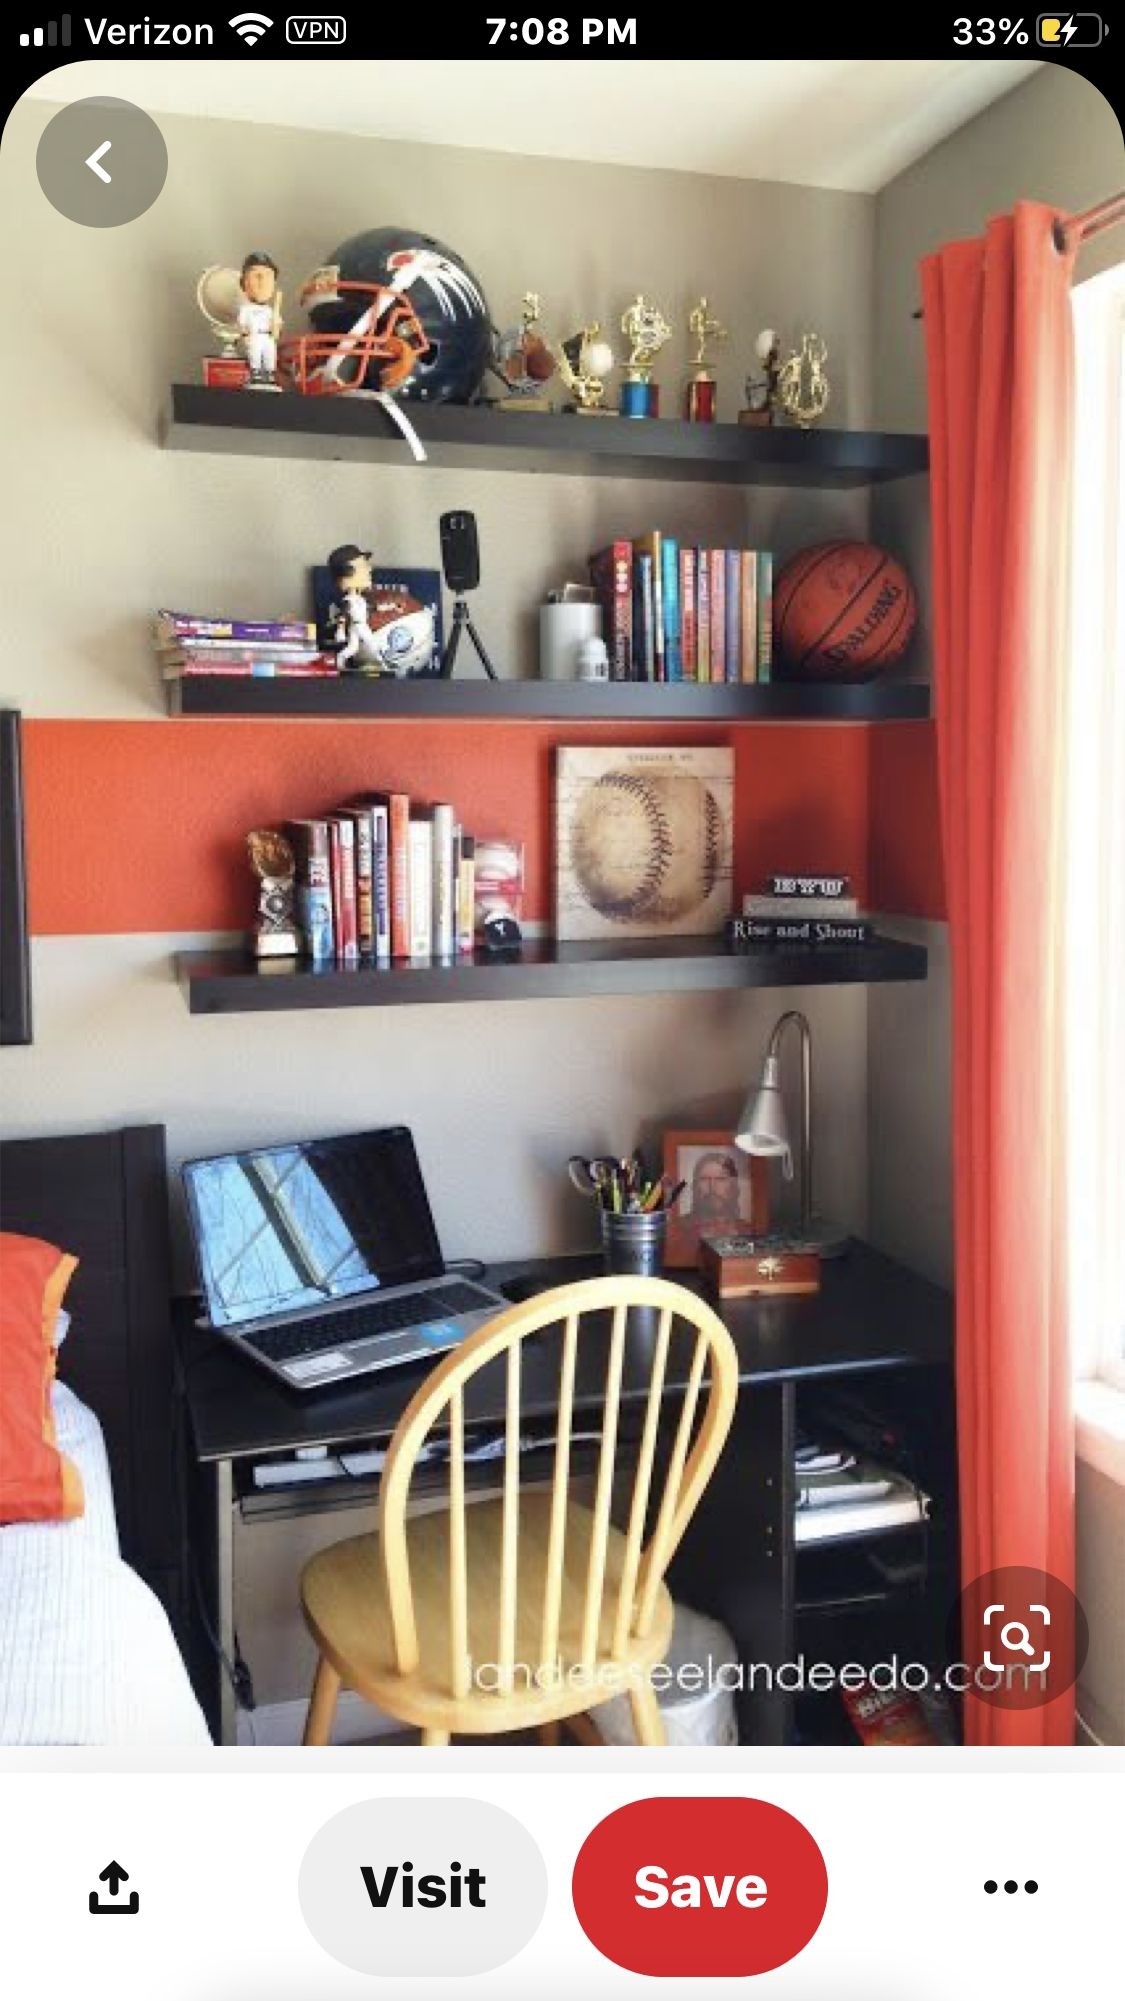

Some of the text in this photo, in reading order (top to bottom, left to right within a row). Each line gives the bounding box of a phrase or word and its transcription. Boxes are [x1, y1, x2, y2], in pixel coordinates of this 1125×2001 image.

[733, 920, 865, 941] Rise and Shout
